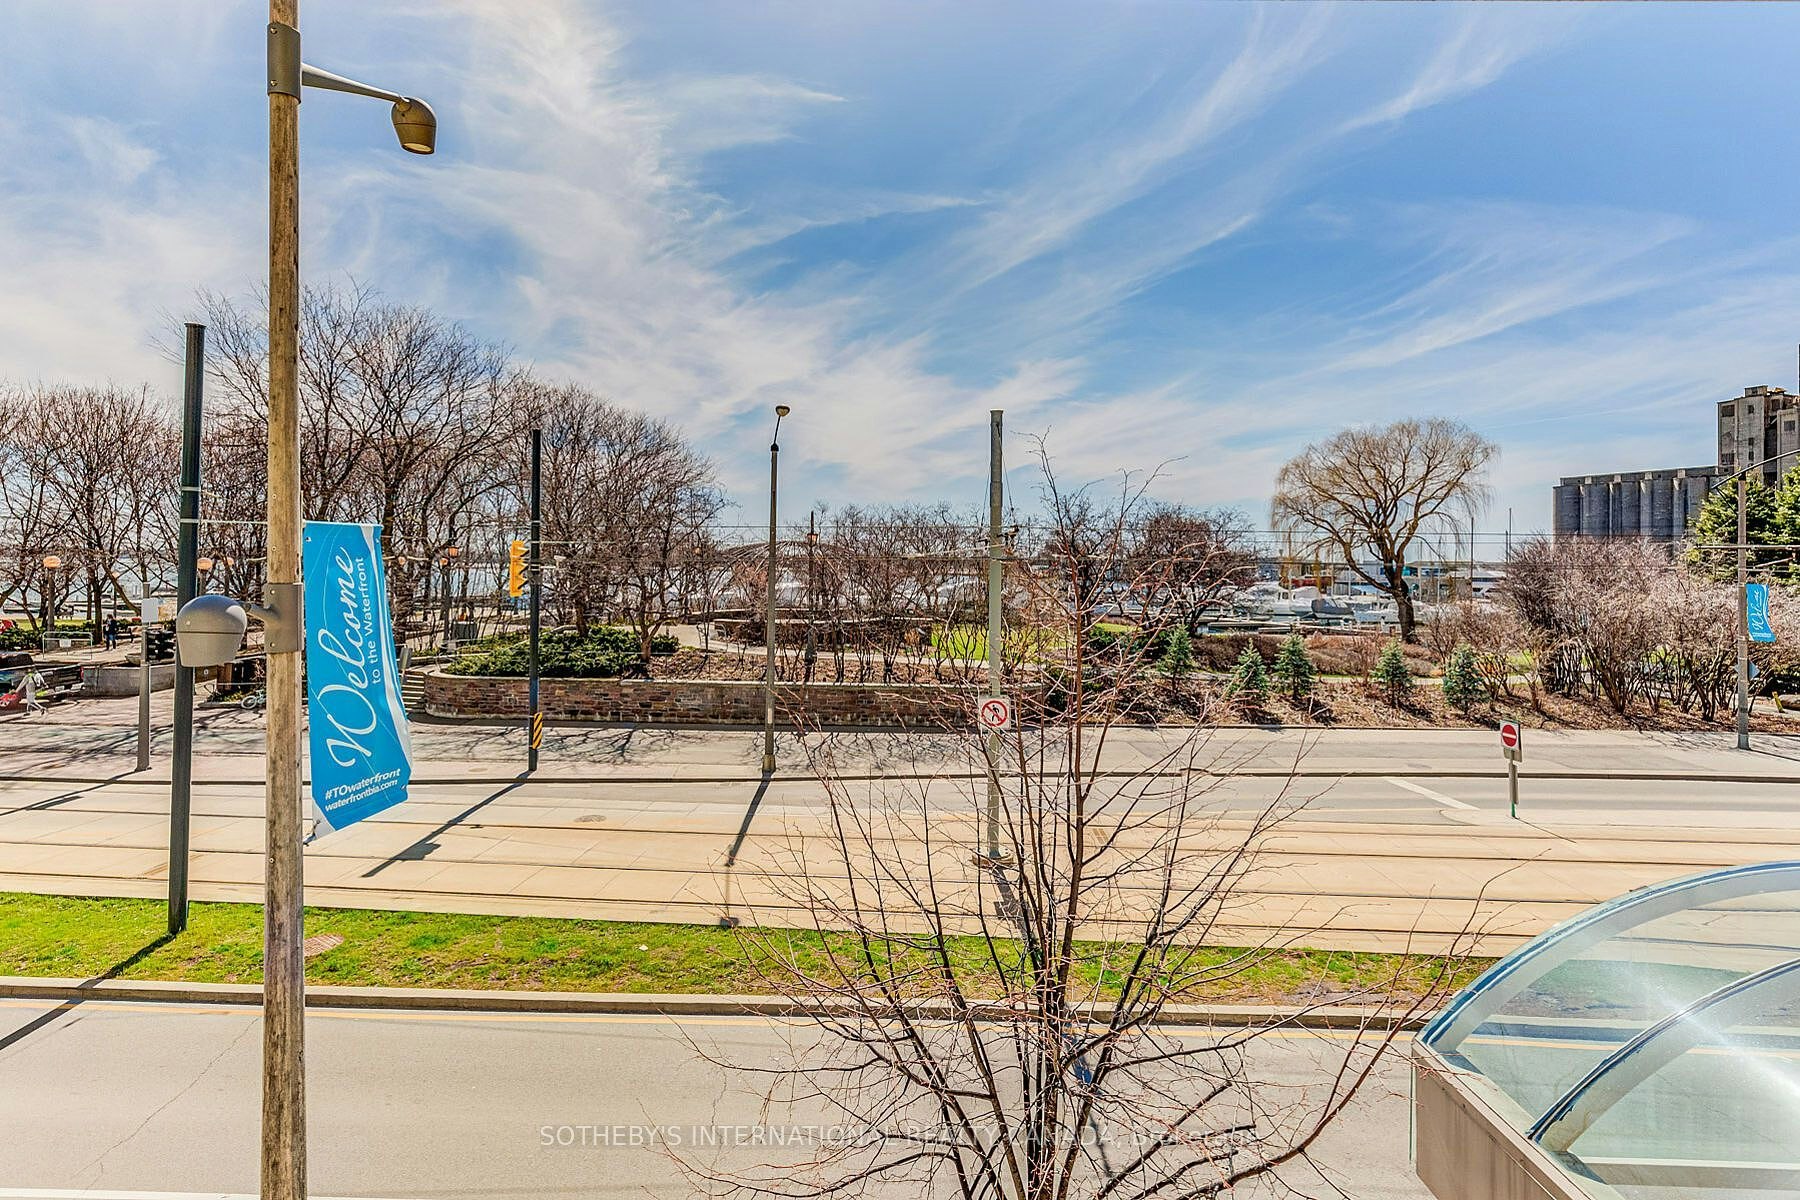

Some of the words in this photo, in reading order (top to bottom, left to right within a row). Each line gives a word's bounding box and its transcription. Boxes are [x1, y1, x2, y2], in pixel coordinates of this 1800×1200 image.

[355, 557, 374, 637] Waterfront
[317, 546, 377, 767] Welcome
[367, 640, 379, 664] the
[372, 669, 381, 684] to
[325, 768, 401, 800] #TOwaterfront
[325, 779, 398, 812] waterfrontbia.com
